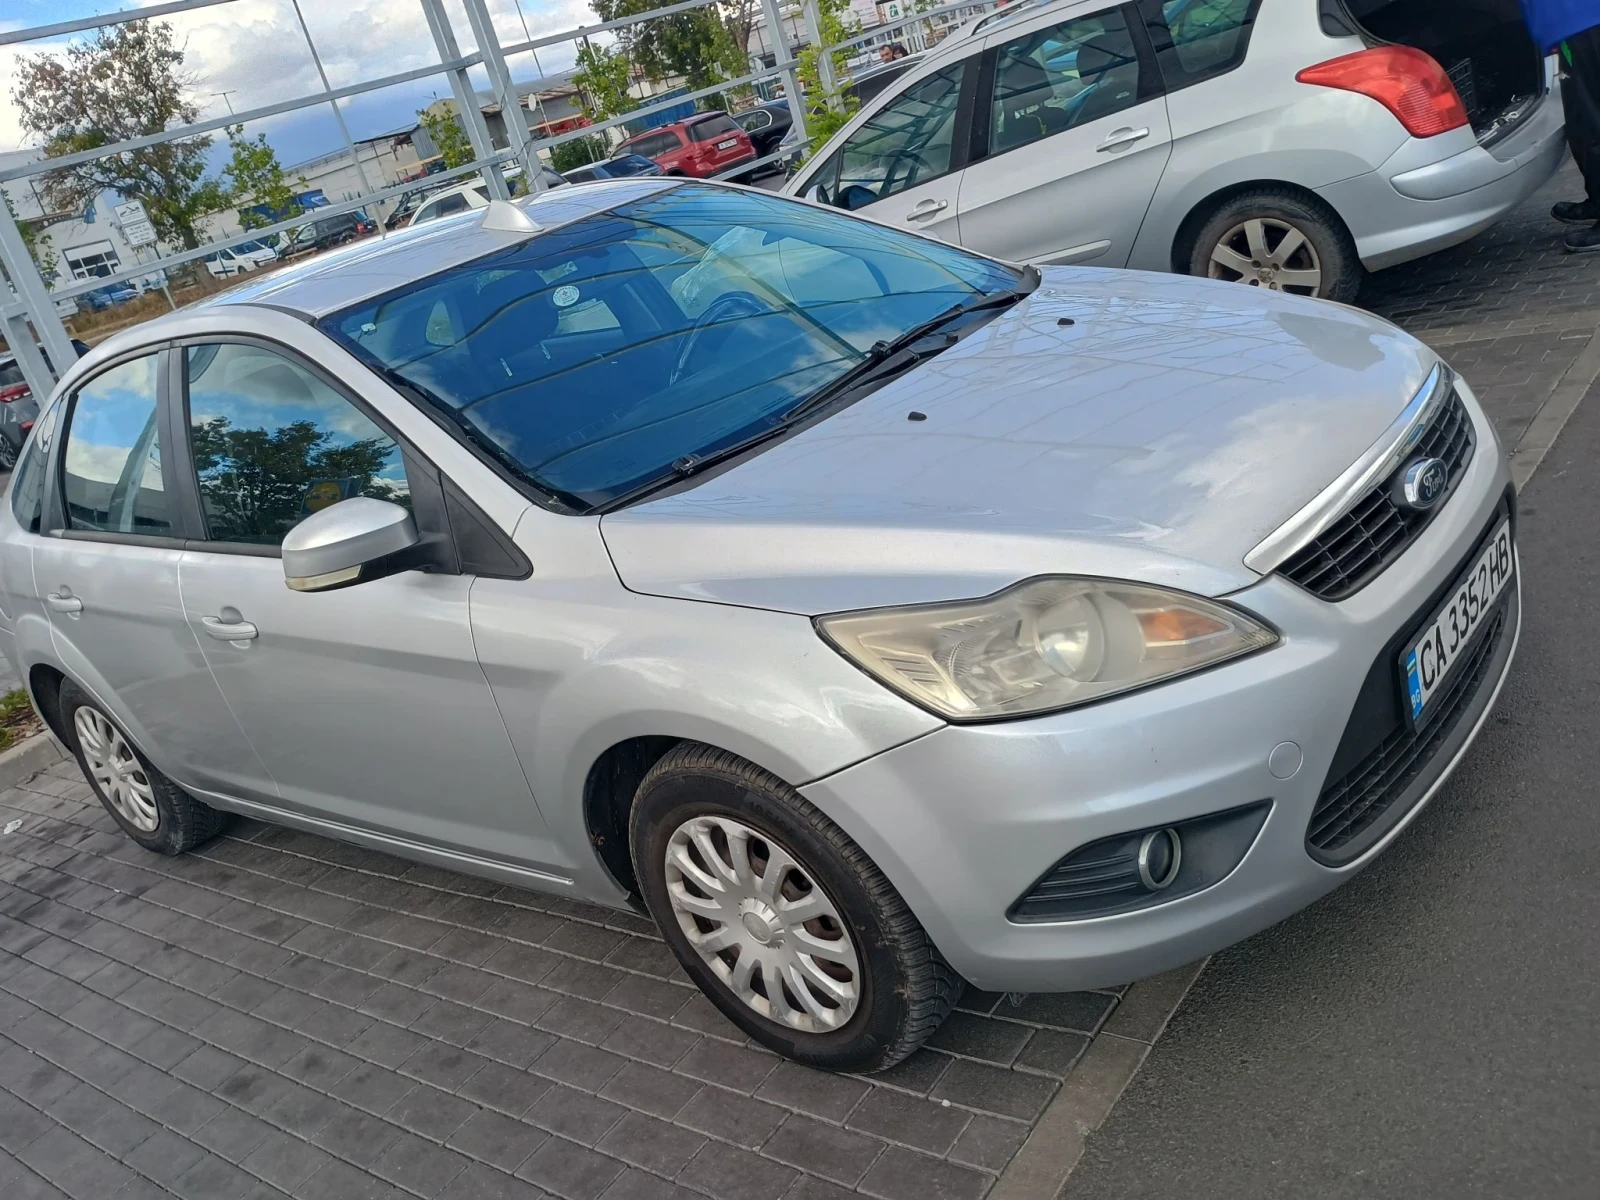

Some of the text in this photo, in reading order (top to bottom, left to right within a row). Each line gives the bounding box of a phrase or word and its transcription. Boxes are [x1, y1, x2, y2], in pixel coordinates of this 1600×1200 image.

[1423, 467, 1444, 498] Ford
[1420, 532, 1509, 691] CA 3352 HB
[1411, 688, 1420, 710] BG
